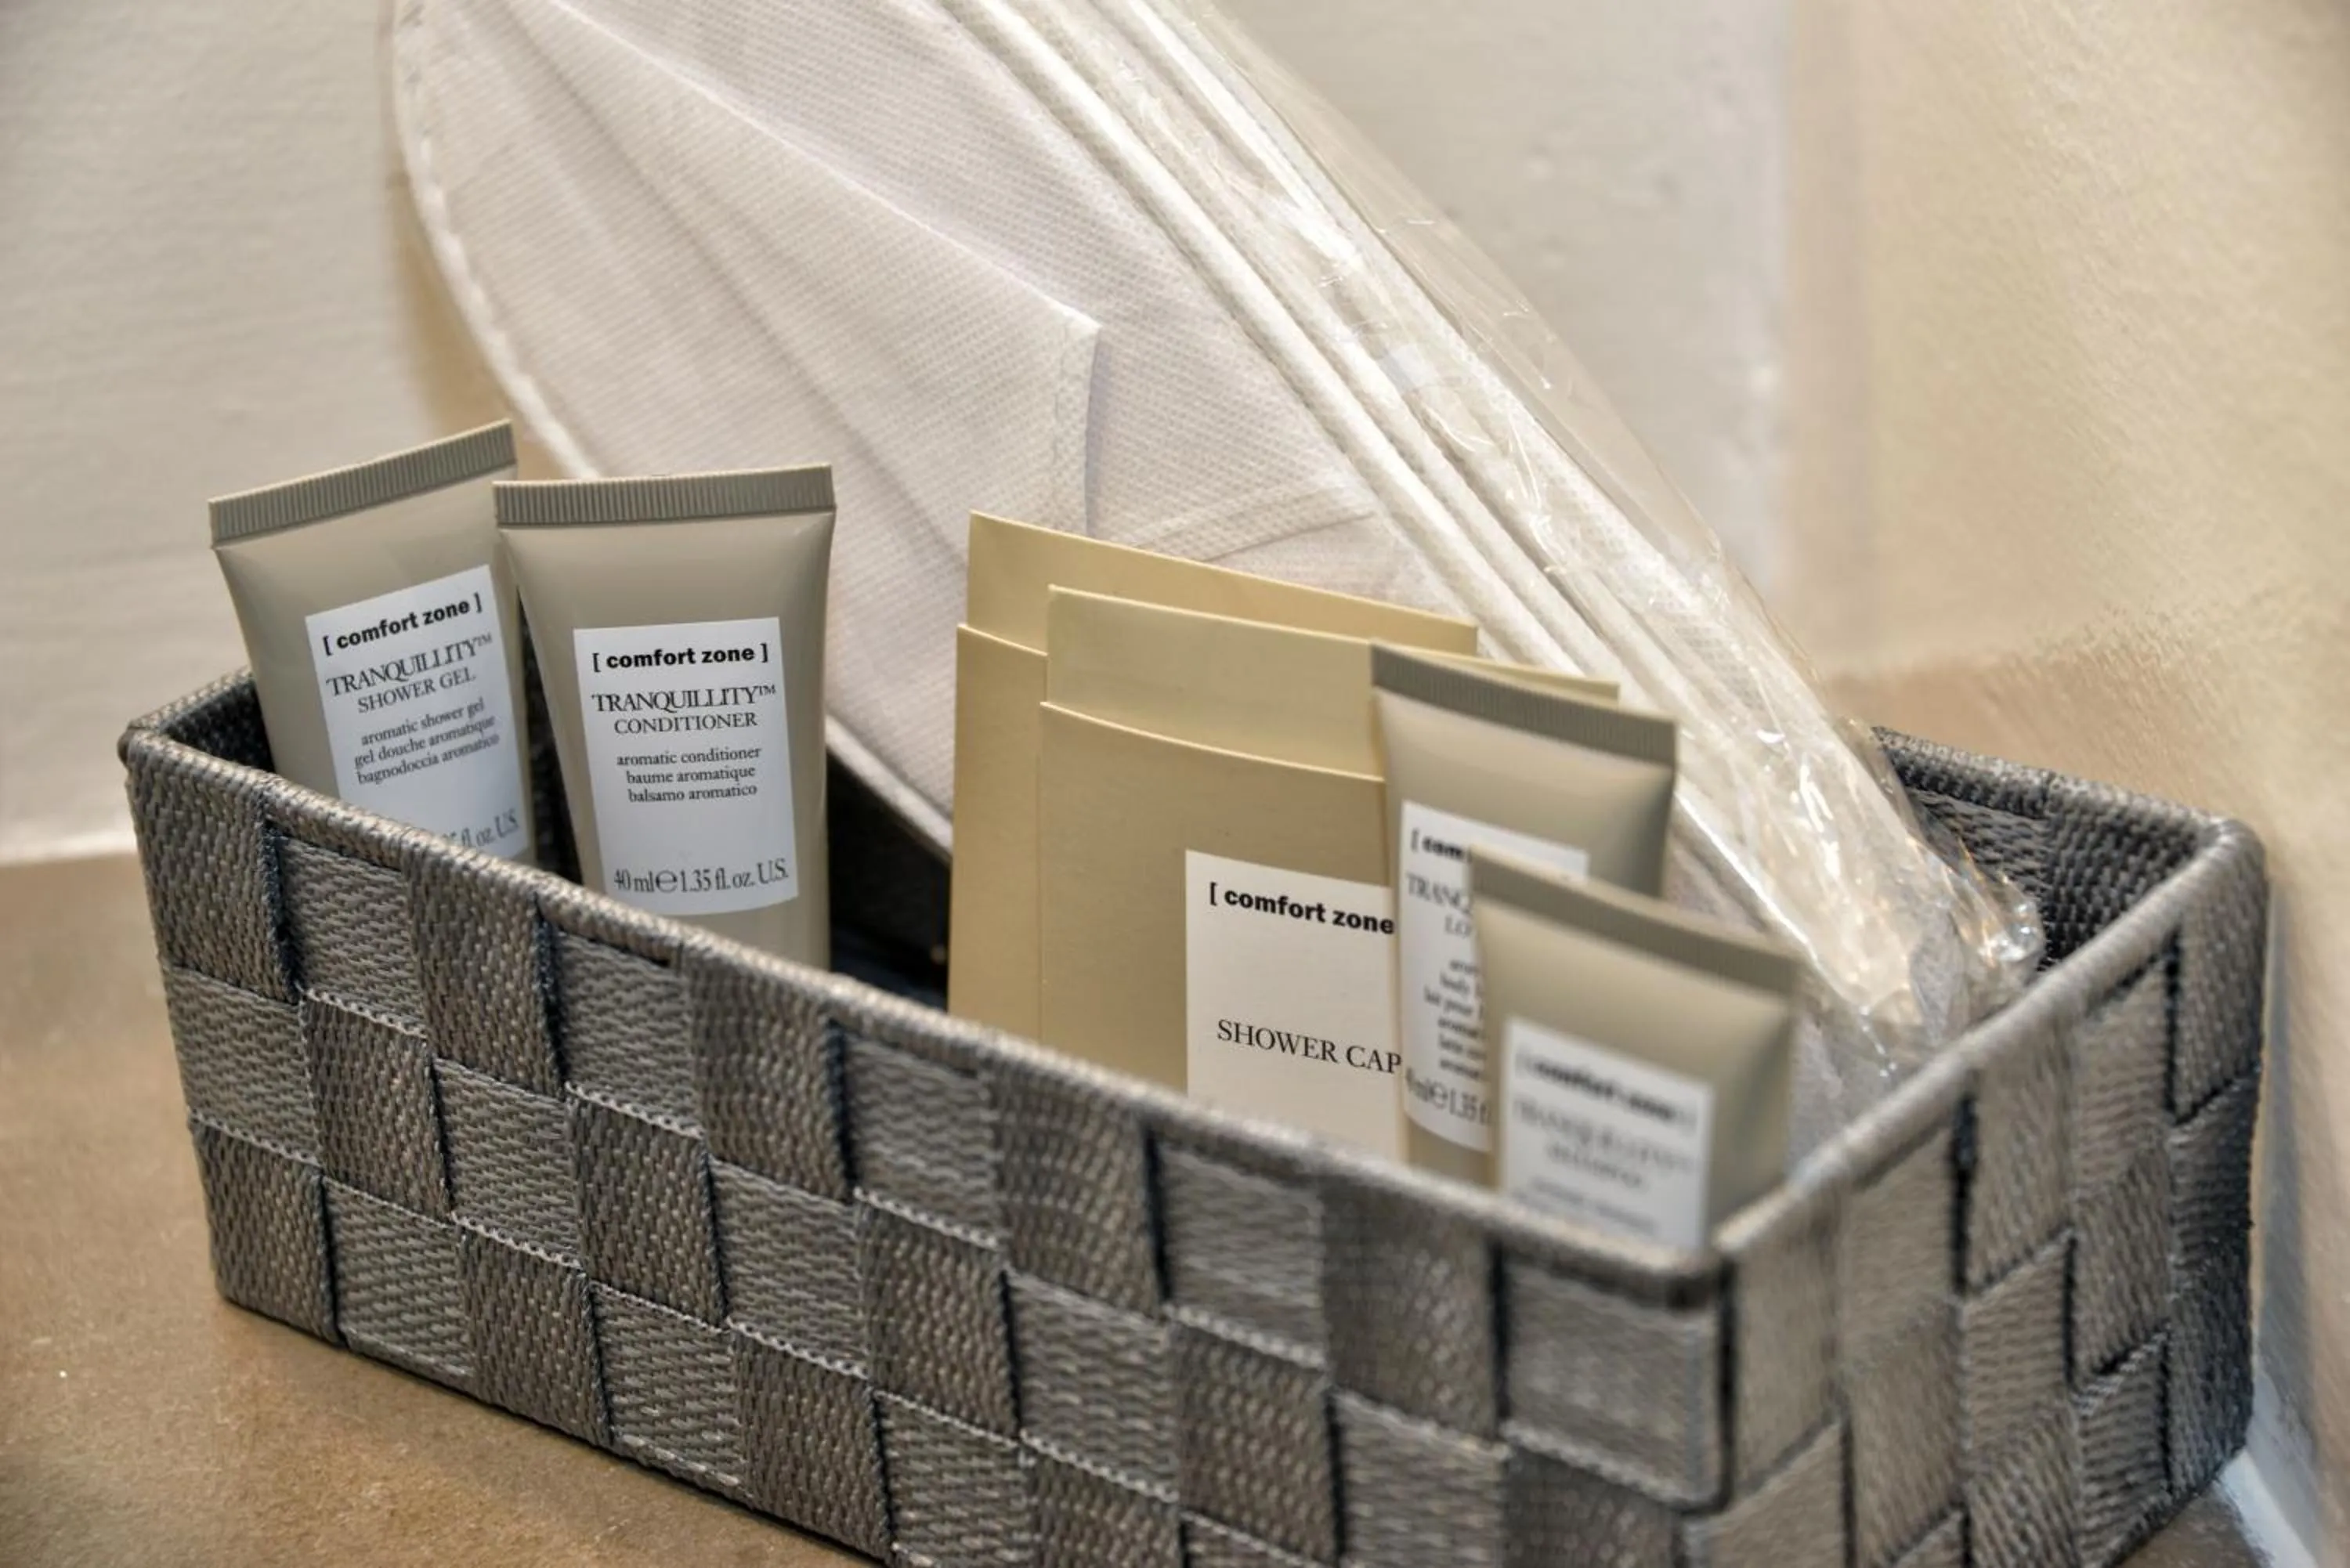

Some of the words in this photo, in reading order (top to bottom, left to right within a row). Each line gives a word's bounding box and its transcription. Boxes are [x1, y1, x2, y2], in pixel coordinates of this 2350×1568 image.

[357, 677, 436, 714] SHOWER
[439, 667, 476, 692] GEL
[354, 748, 374, 770] gel
[378, 733, 425, 761] douche
[428, 715, 497, 748] aromatique
[361, 718, 418, 746] aromatic
[421, 709, 465, 729] shower
[467, 696, 486, 720] gel
[614, 712, 758, 735] CONDITIONER
[356, 751, 439, 785] bagnodoccia
[442, 733, 501, 764] aromatico
[616, 752, 677, 766] aromatic
[681, 746, 762, 764] conditioner
[626, 770, 674, 785] baume
[677, 765, 756, 785] aromatique
[628, 786, 685, 803] balsamo
[688, 783, 757, 800] aromatico
[1217, 1019, 1339, 1064] SHOWER
[1346, 1046, 1402, 1075] CAP
